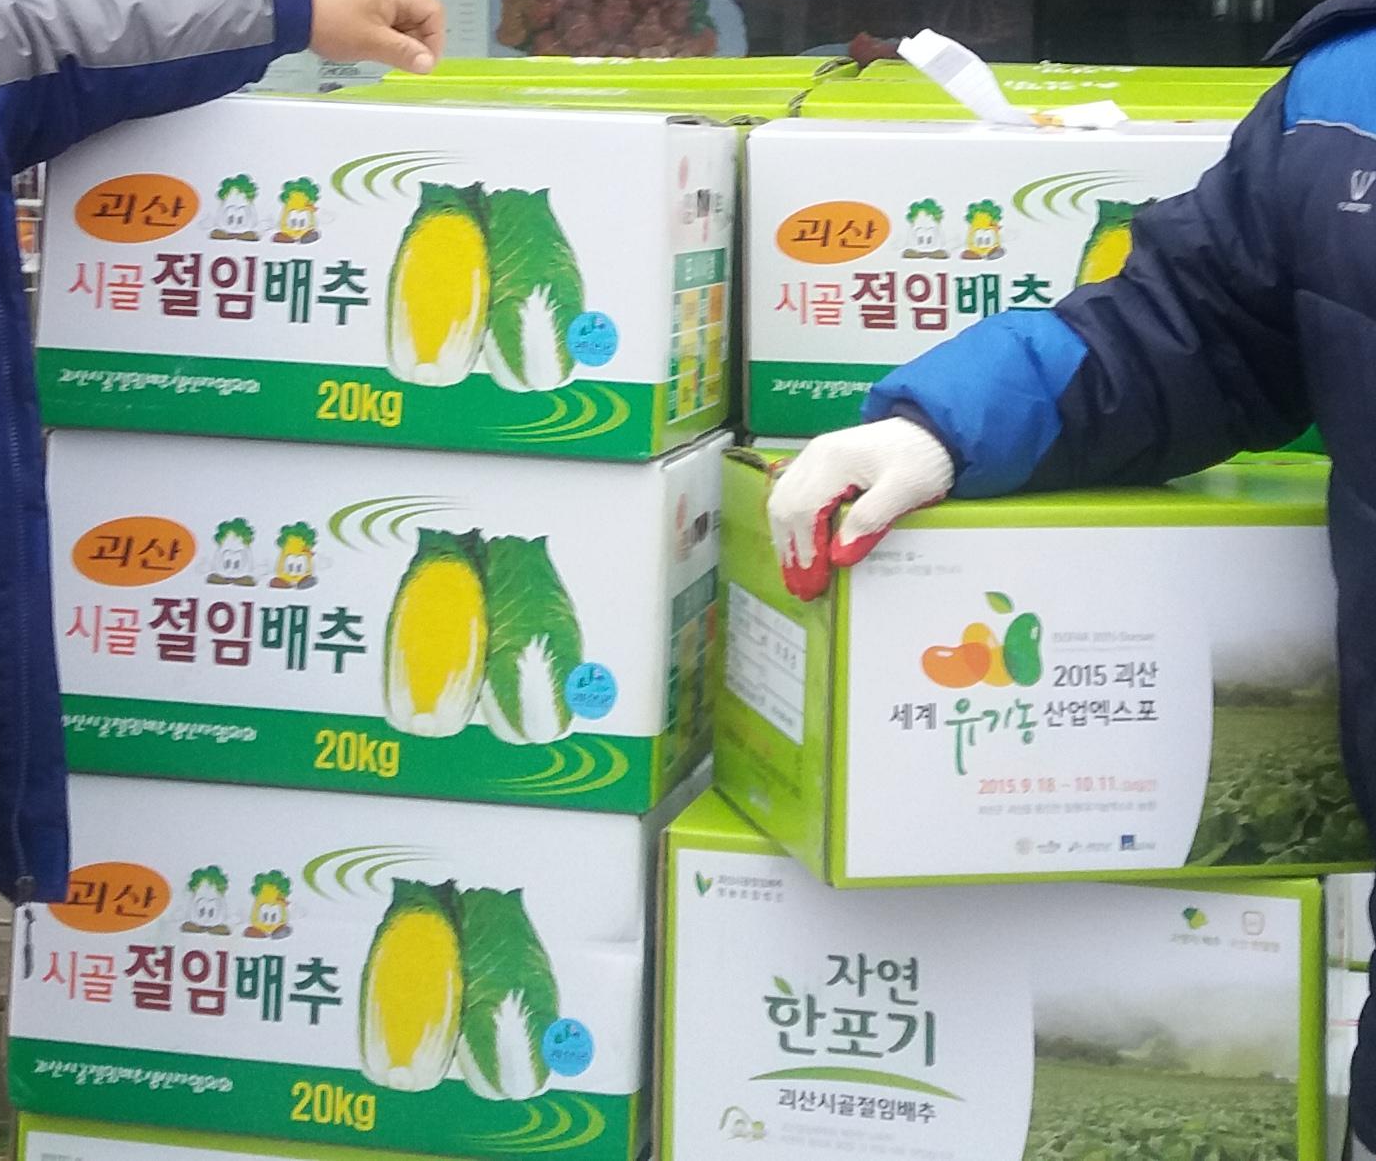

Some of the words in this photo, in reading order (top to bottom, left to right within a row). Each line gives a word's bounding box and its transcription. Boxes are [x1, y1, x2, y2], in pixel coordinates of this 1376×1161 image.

[92, 192, 186, 227] 괴산
[790, 219, 881, 251] 괴산
[64, 261, 144, 312] 시골
[151, 250, 370, 326] 절임배추
[775, 280, 845, 326] 시골
[316, 379, 403, 429] 20kg
[88, 533, 182, 570] 괴산
[65, 603, 141, 657] 시골
[149, 597, 366, 673] 절임배추
[1052, 665, 1107, 687] 2015
[1112, 661, 1159, 688] 괴산
[314, 730, 400, 778] 20kg
[889, 702, 937, 730] 세계
[944, 697, 1038, 776] 유기농
[1043, 700, 1159, 727] 산업엑스포
[70, 881, 158, 917] 괴산
[42, 950, 118, 1003] 시골
[125, 943, 342, 1025] 절임배추
[825, 952, 919, 1006] 자연
[763, 975, 938, 1067] 한포기
[291, 1081, 377, 1131] 20kg
[778, 1088, 937, 1124] 괴산시골절임배추
